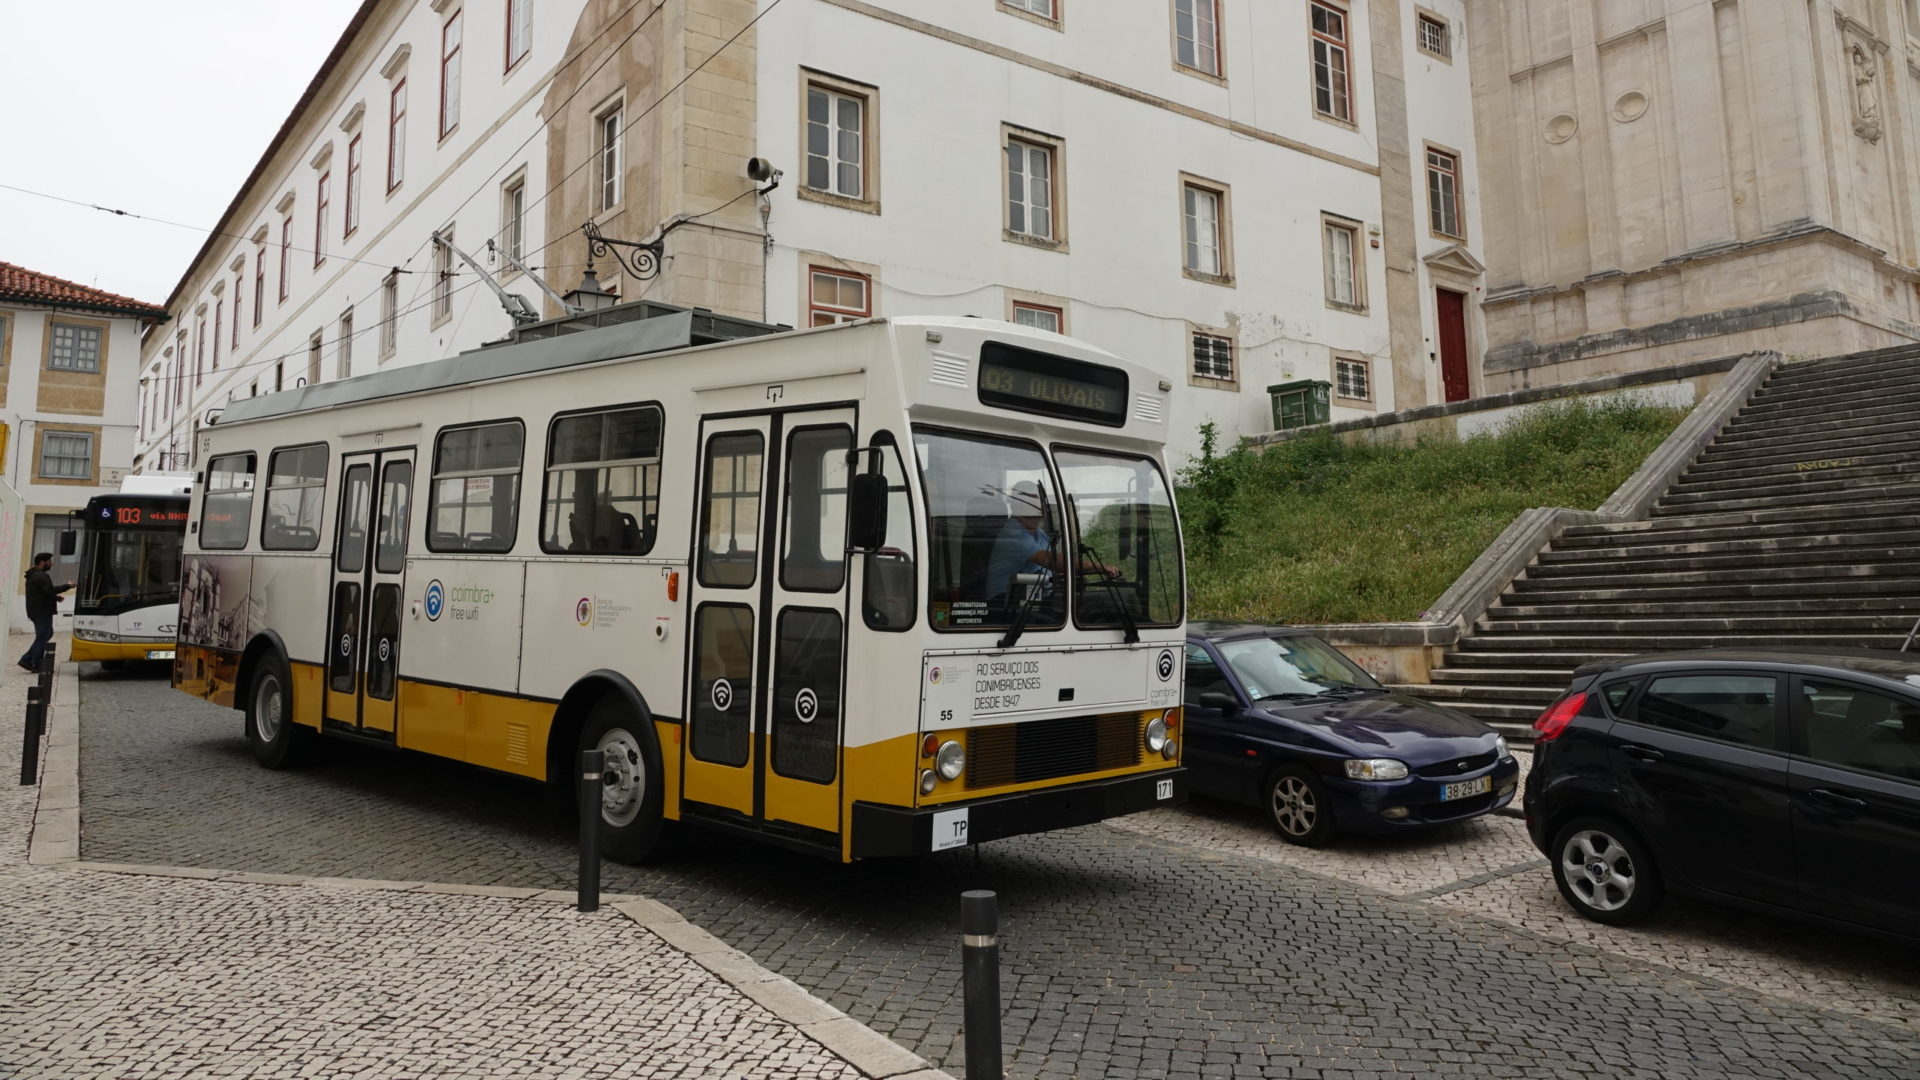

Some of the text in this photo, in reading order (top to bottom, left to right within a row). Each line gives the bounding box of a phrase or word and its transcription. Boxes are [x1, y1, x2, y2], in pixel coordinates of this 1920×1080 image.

[1030, 377, 1106, 410] OLIVAIS
[117, 507, 141, 524] 103
[450, 605, 465, 620] free
[976, 663, 988, 676] AO
[989, 661, 1022, 676] SERVIÇO
[1023, 661, 1039, 674] DOS
[975, 677, 1041, 693] CONIMBRICENSES
[974, 694, 1021, 710] DESDE 1947
[940, 709, 953, 721] 55
[1158, 782, 1172, 798] 171
[952, 820, 967, 837] TP
